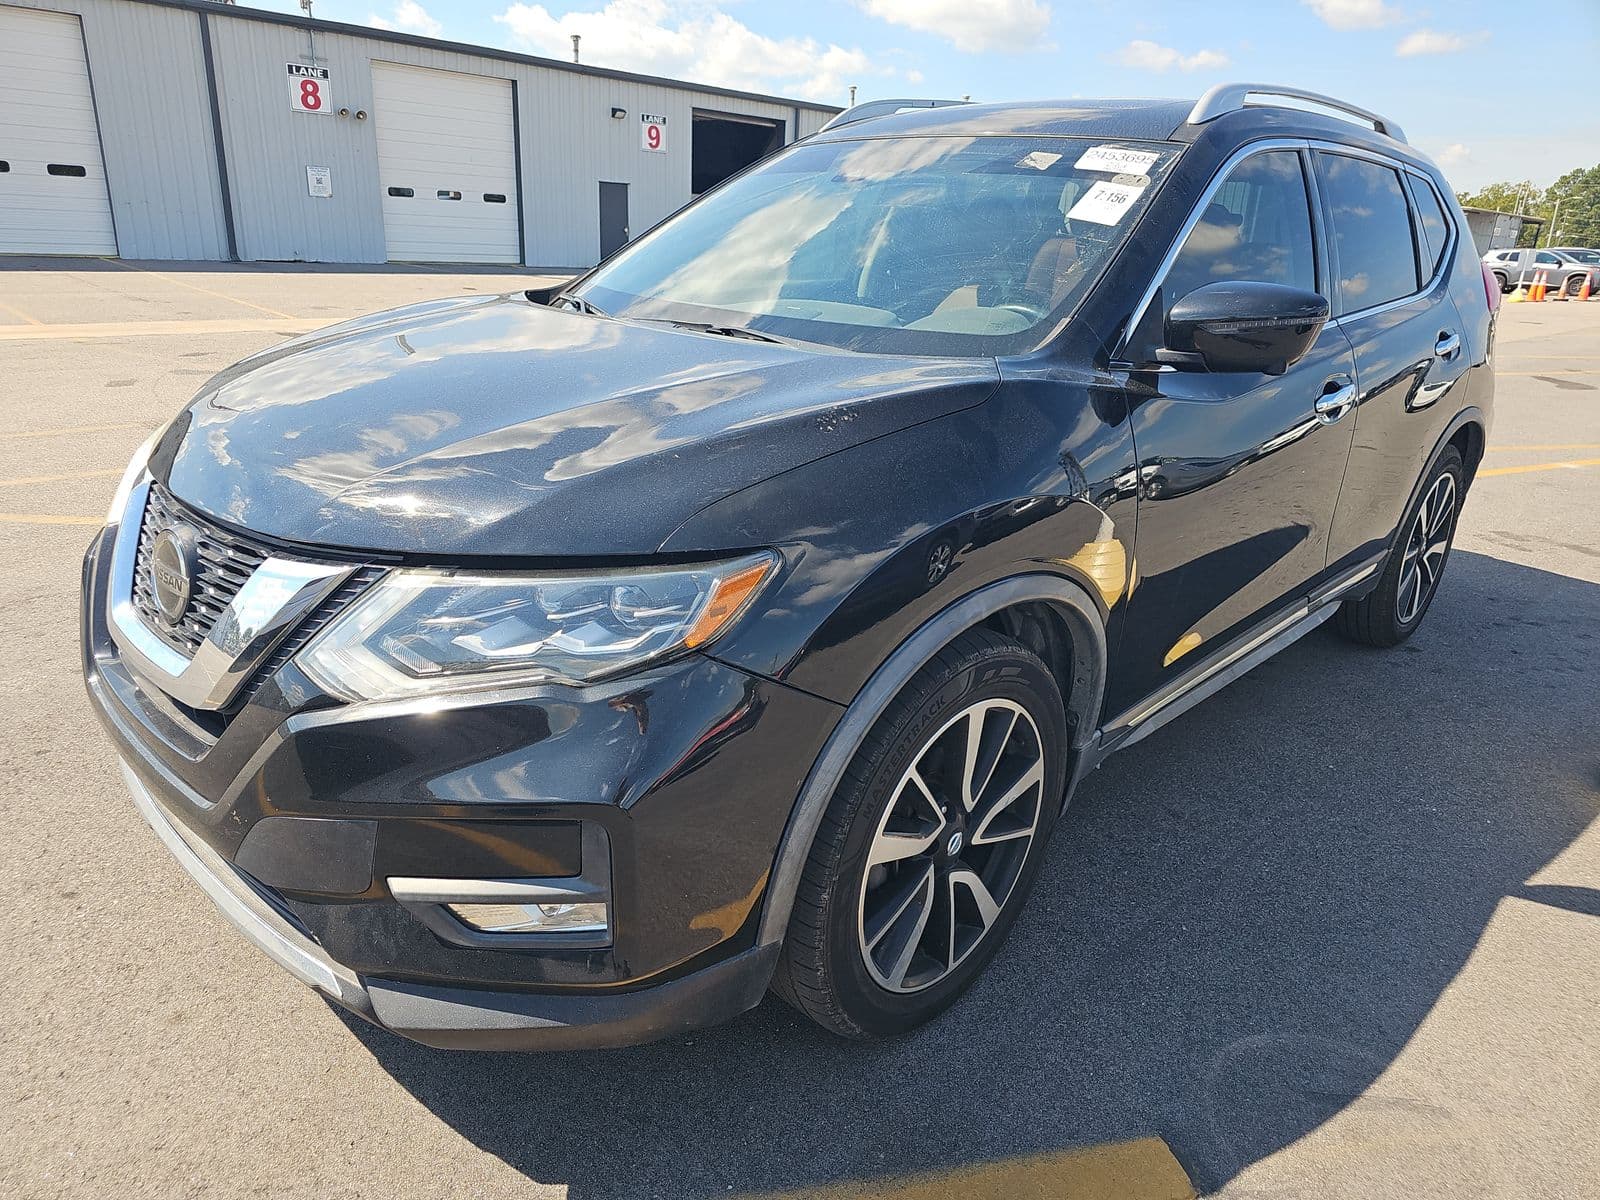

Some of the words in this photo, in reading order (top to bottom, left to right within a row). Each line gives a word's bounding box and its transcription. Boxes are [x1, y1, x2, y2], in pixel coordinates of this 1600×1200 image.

[292, 65, 324, 78] LANE
[300, 79, 322, 110] 8
[644, 114, 665, 125] LANE
[647, 125, 660, 149] 9
